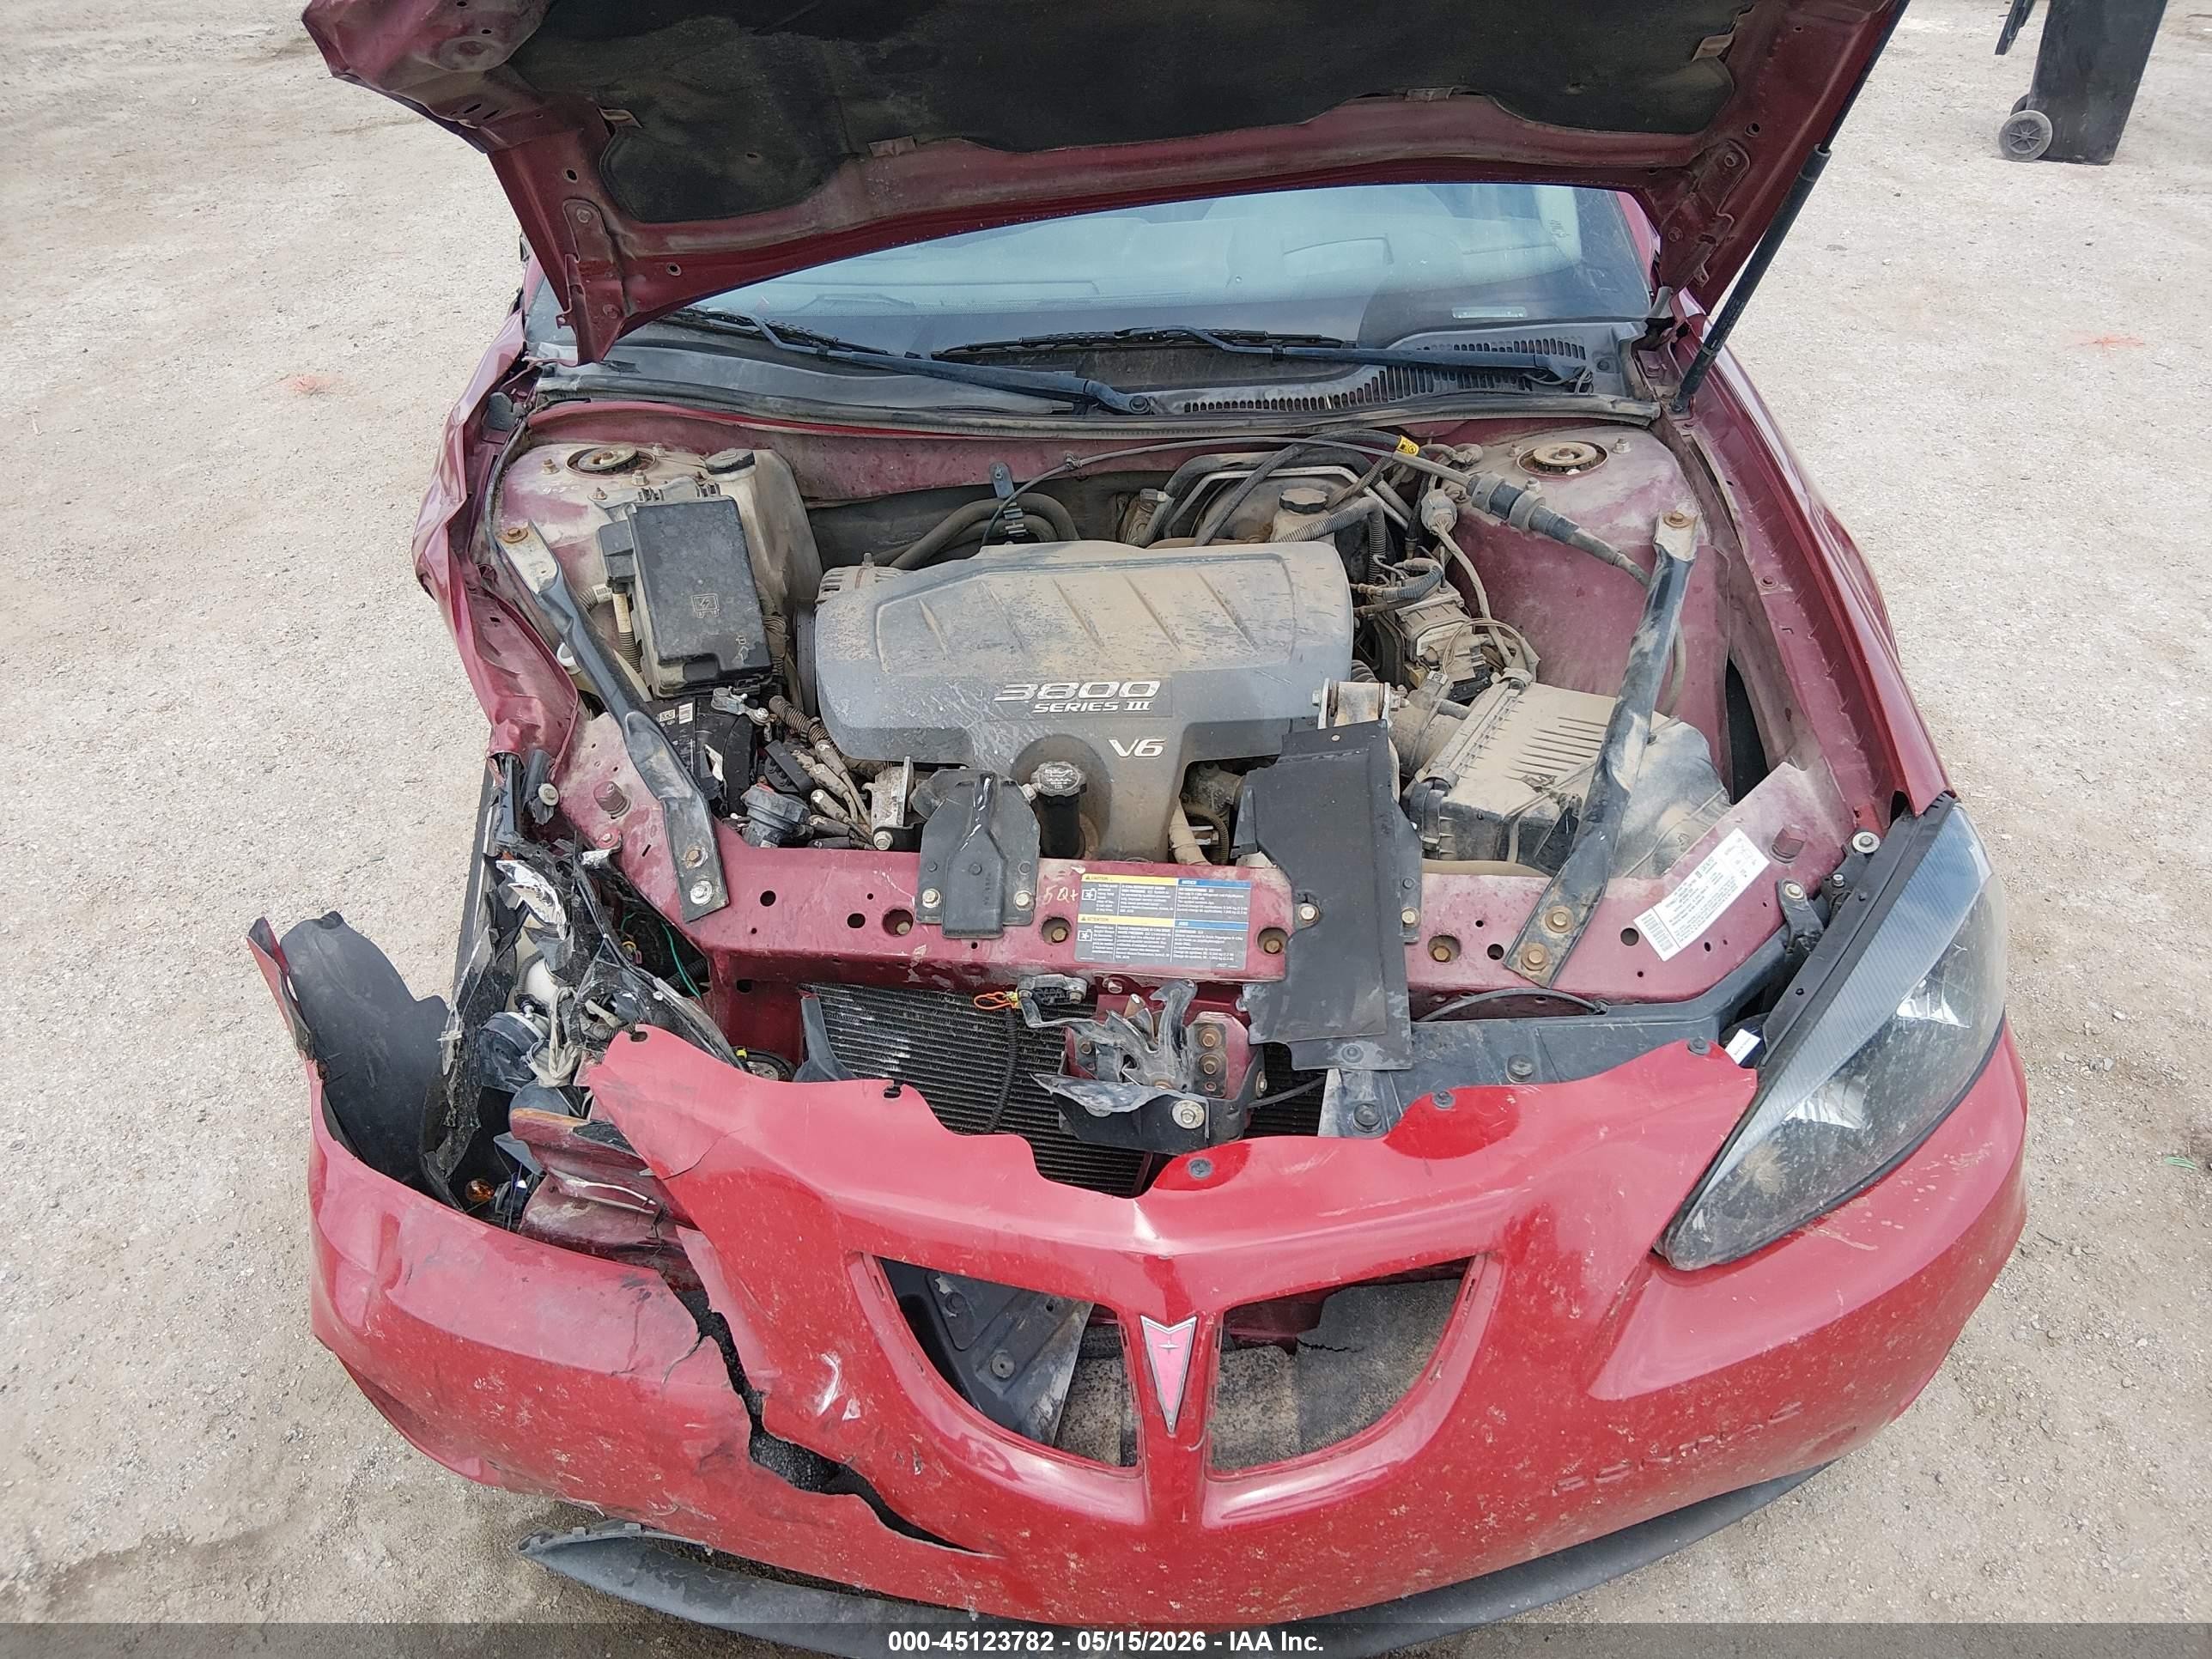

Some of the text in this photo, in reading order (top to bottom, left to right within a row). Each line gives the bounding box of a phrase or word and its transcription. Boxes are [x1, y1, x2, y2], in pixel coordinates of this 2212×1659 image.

[994, 681, 1161, 702] 3800
[1032, 701, 1155, 714] SERIES III
[1109, 738, 1166, 757] V6
